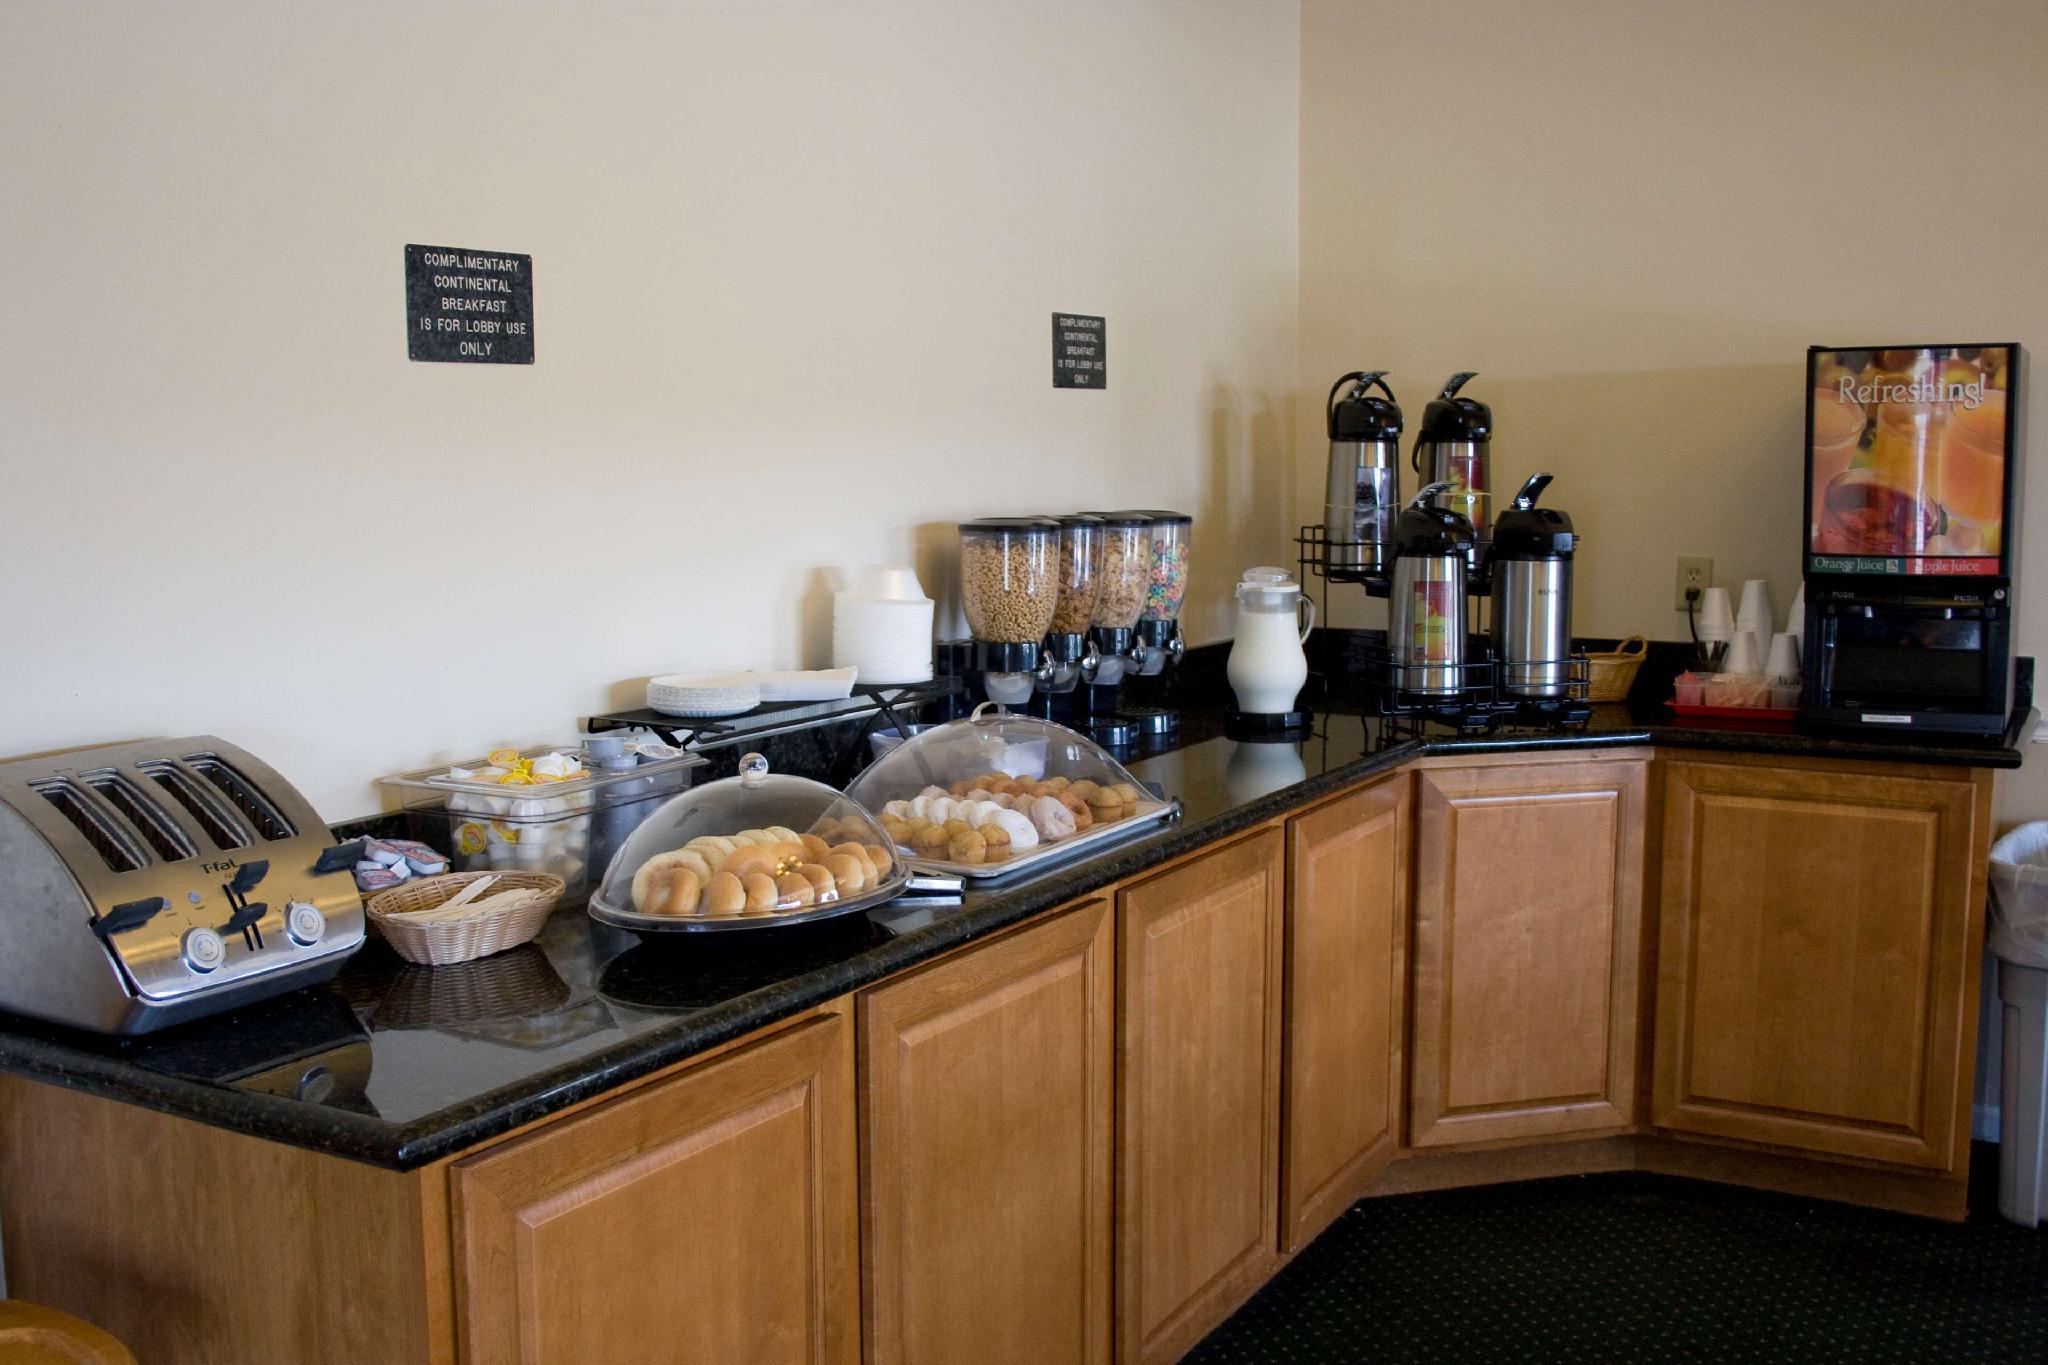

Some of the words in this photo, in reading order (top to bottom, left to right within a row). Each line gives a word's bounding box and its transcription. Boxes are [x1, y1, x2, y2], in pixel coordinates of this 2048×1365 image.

[424, 252, 519, 272] COMPLIMENTARY
[434, 275, 512, 293] CONTINENTAL
[441, 297, 507, 313] BREAKFAST
[420, 318, 432, 331] IS
[437, 318, 460, 332] FOR
[466, 320, 501, 334] LOBBY
[506, 322, 527, 335] USE
[1060, 318, 1101, 328] COMPLIMENTARY
[1064, 332, 1098, 342] CONTINENTAL
[460, 341, 492, 356] ONLY
[1066, 345, 1095, 356] BREAKFAST
[1058, 360, 1064, 368] IS
[1065, 360, 1076, 368] FOR
[1077, 361, 1093, 369] LOBBY
[1094, 362, 1103, 370] USE
[1074, 374, 1089, 383] ONLY
[1837, 372, 1986, 409] Refreshing!
[1814, 557, 1854, 573] Orange
[1857, 559, 1884, 572] Juice
[1950, 559, 1980, 574] Juice
